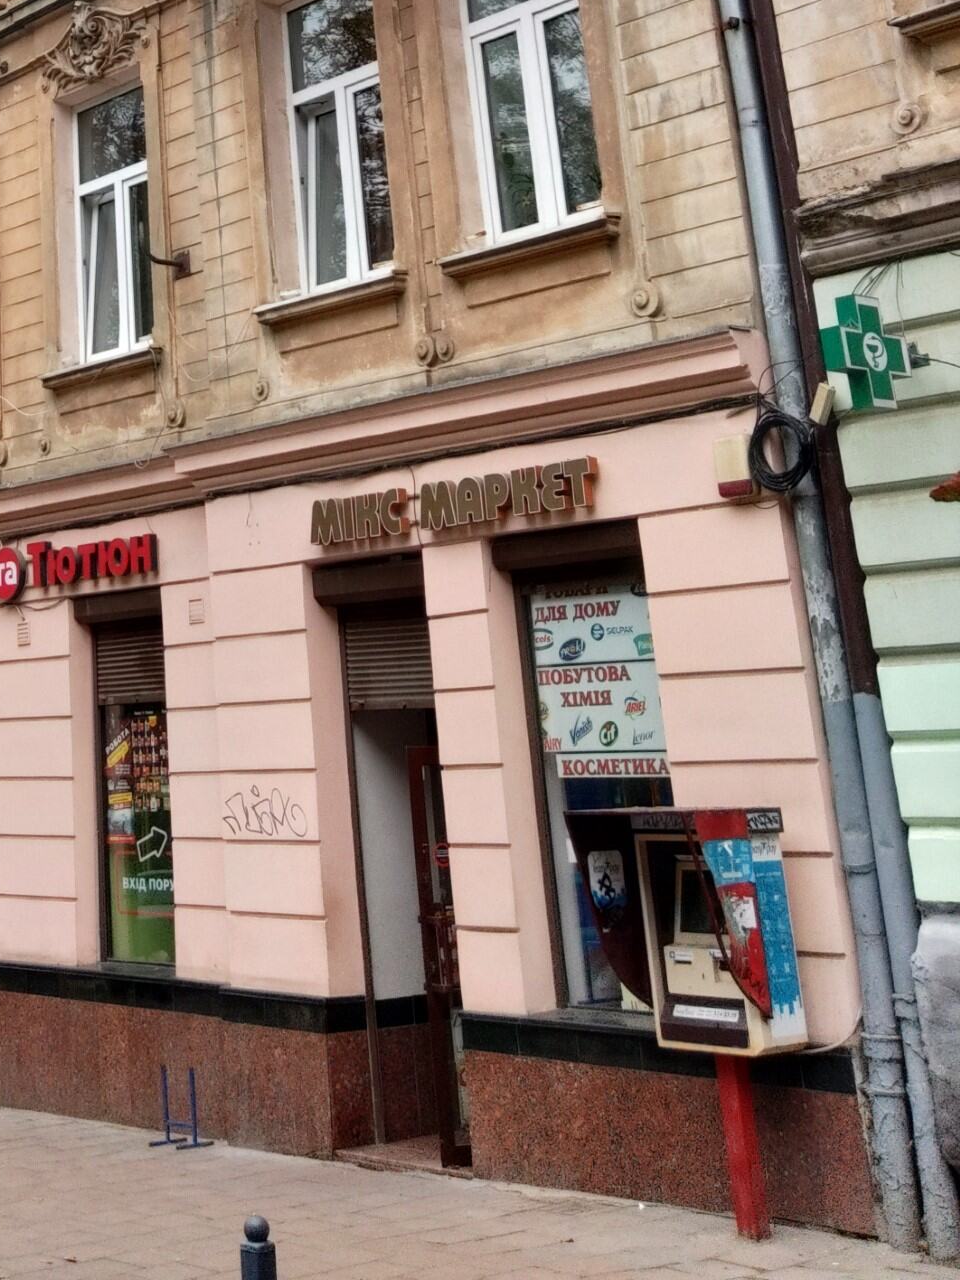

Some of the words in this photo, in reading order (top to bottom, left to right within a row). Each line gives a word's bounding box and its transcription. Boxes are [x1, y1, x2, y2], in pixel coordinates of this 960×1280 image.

[311, 488, 407, 545] МІКС
[420, 456, 597, 531] МАРКЕТ
[27, 533, 158, 587] Тютюн
[535, 605, 568, 625] ДЛЯ
[573, 600, 621, 622] ДОМУ
[537, 665, 631, 686] ПОБУТОВА
[561, 690, 612, 708] ХІМІЯ
[625, 701, 646, 714] ARIEL
[570, 715, 593, 746] Vanish
[633, 728, 655, 745] Lenor
[105, 727, 130, 755] РОБОТА
[543, 737, 562, 751] AIRY
[561, 758, 671, 776] КОСМЕТИКА
[122, 877, 147, 893] ВХІД
[148, 878, 174, 891] ПОРУ
